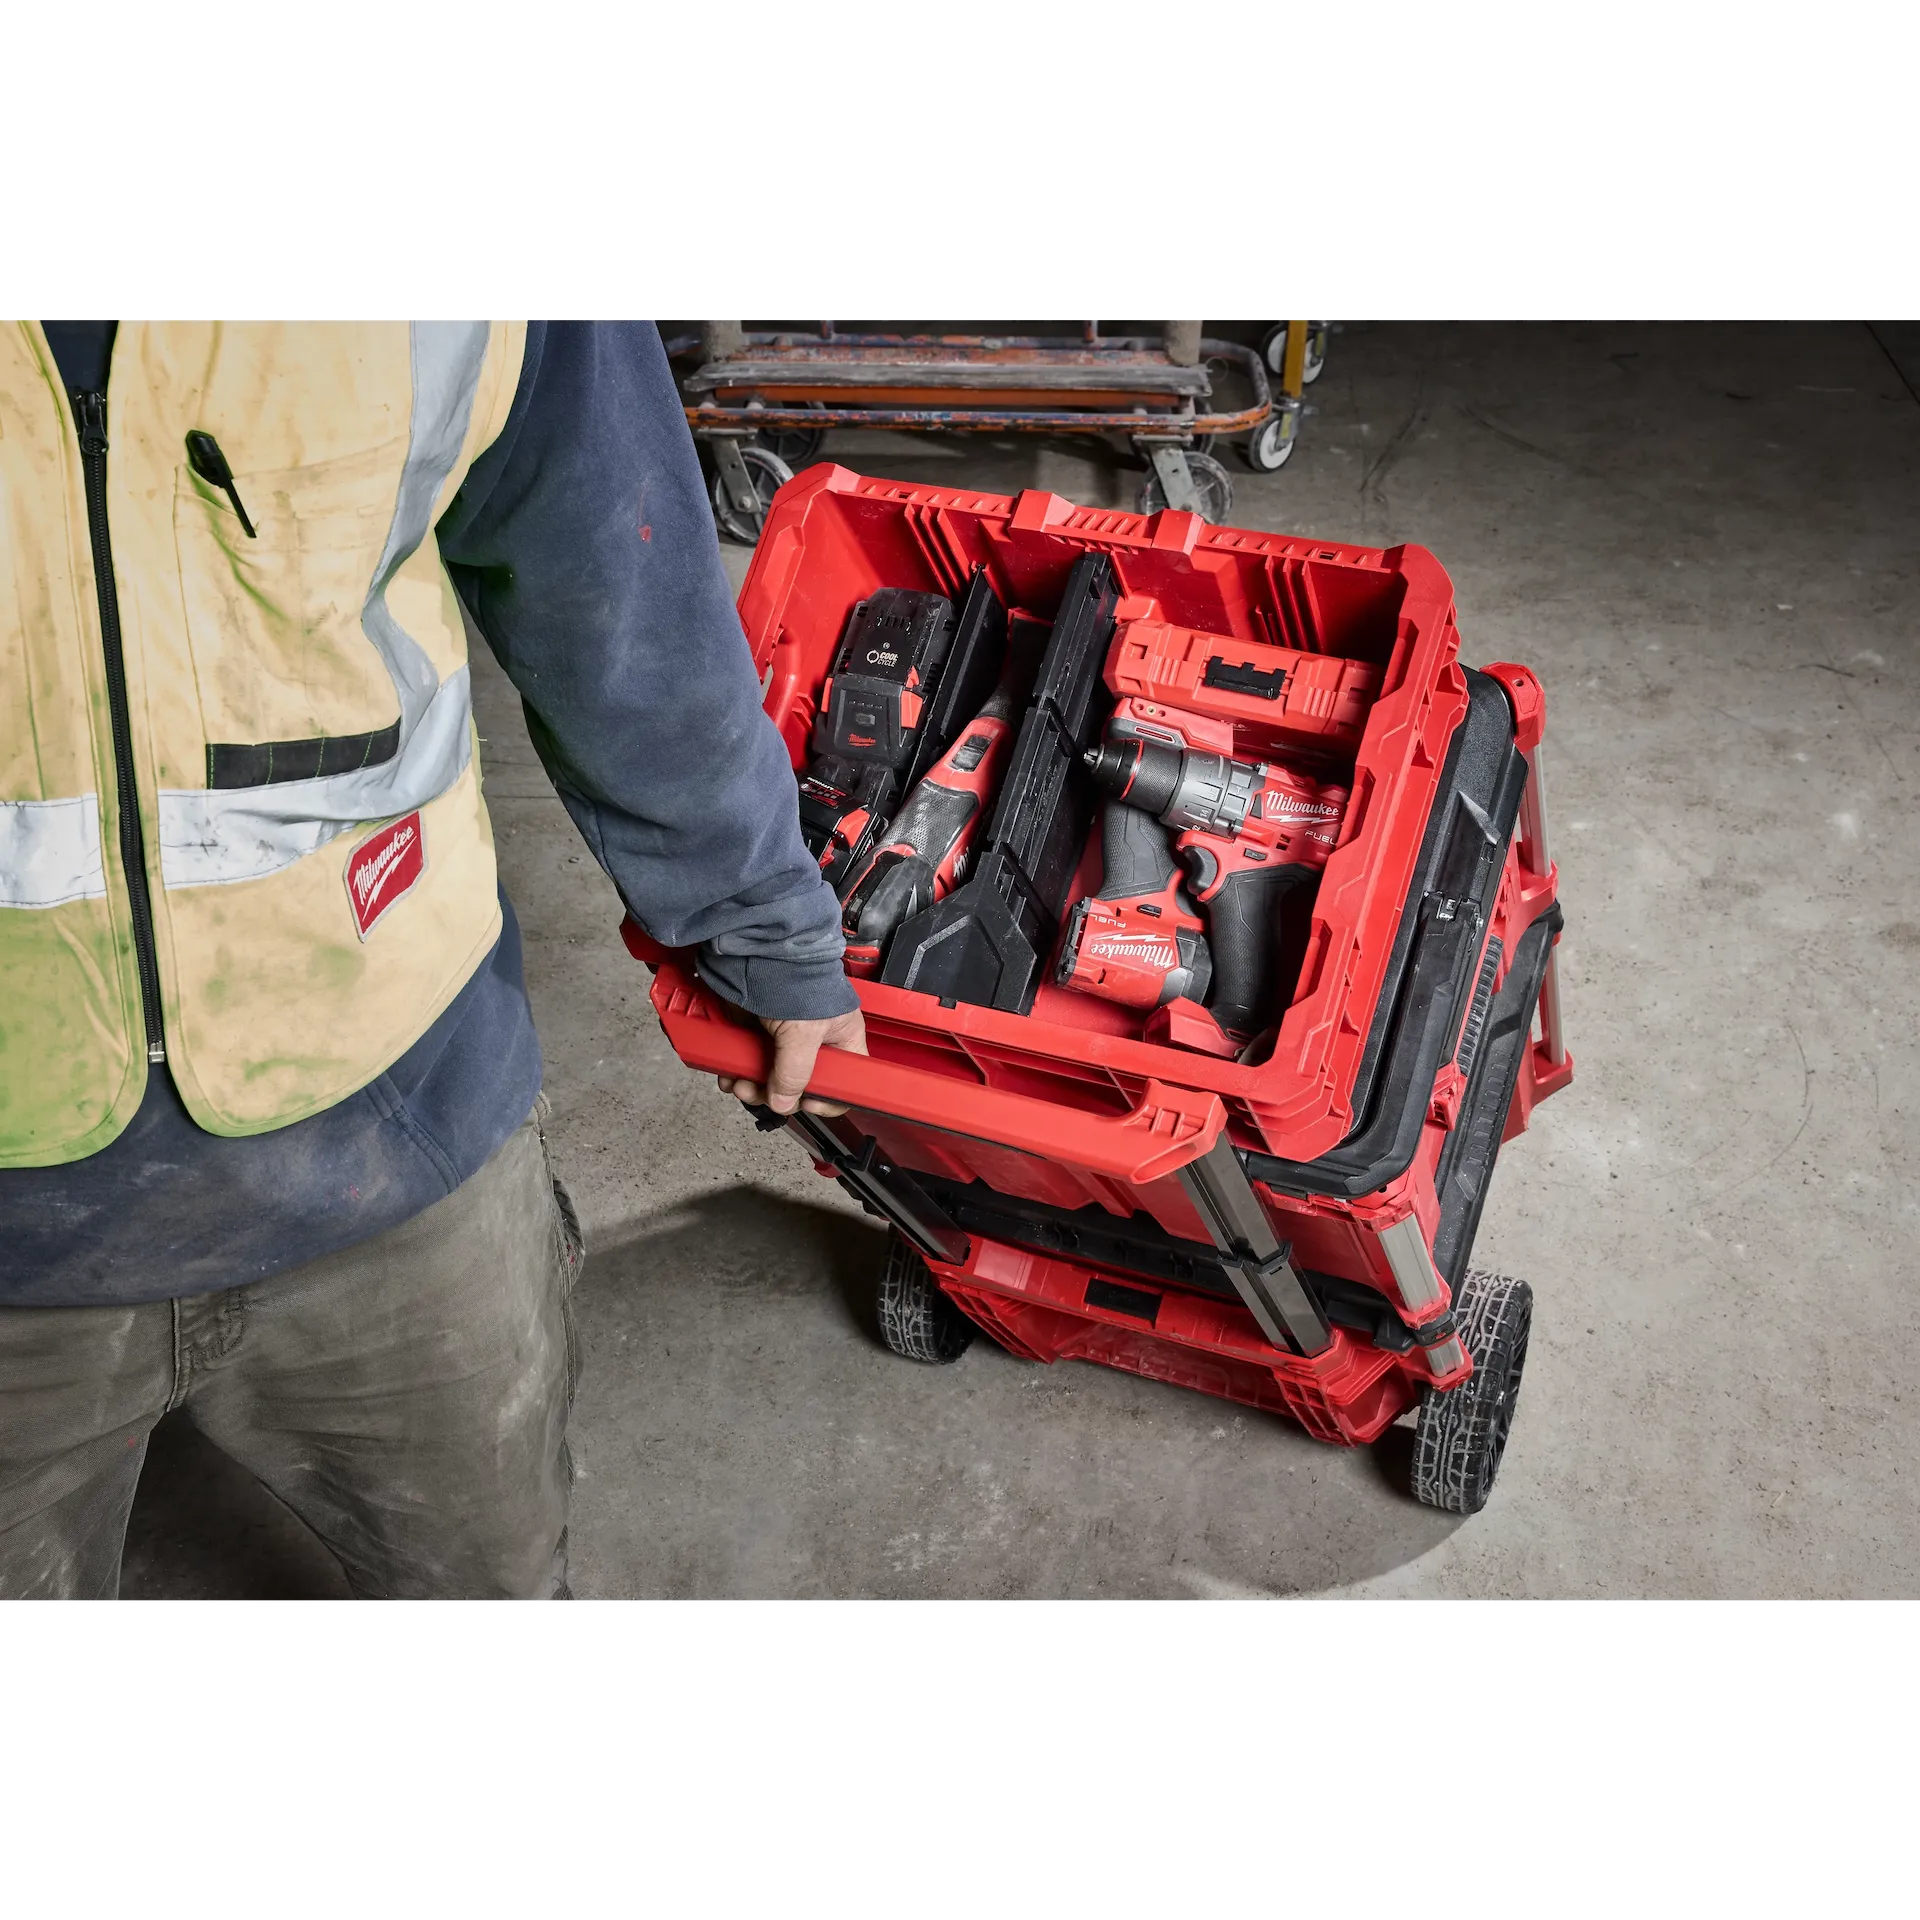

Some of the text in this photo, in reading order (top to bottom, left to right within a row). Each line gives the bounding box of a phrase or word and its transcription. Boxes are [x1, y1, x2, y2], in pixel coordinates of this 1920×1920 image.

[877, 659, 896, 667] CYCLE
[1265, 790, 1339, 816] Milwaukee
[1304, 829, 1336, 846] FUEL
[353, 825, 415, 906] Milwaukee
[1089, 913, 1127, 929] FUEL
[1090, 943, 1175, 969] Milwaukee
